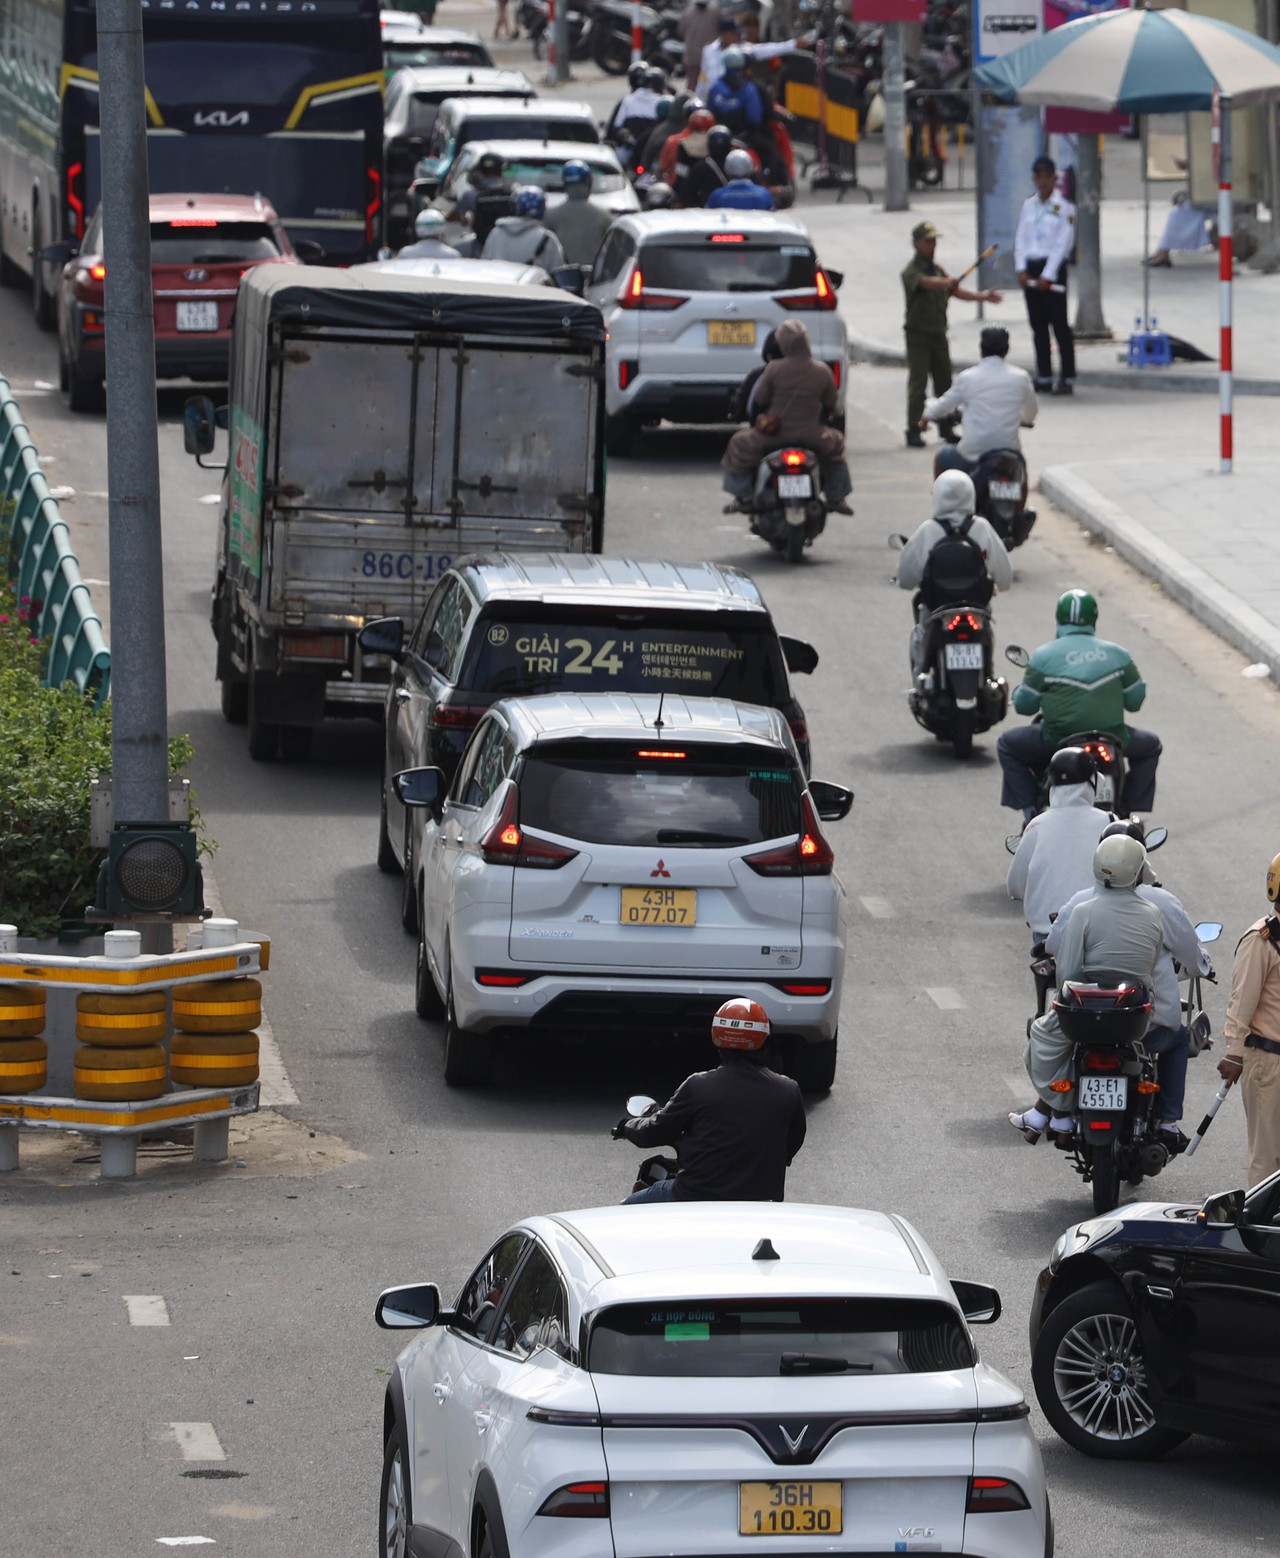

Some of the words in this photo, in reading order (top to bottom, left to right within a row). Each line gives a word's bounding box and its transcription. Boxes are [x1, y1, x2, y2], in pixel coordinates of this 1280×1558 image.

[194, 111, 249, 126] KIA
[491, 629, 505, 643] B2
[515, 632, 560, 655] GIẢI
[564, 638, 624, 675] 24
[622, 641, 634, 653] H
[641, 642, 745, 660] ENTERTAINMENT
[1065, 648, 1108, 666] Grab
[524, 657, 559, 673] TRI
[643, 890, 675, 906] 43H
[628, 907, 688, 923] 077.07
[1087, 1079, 1118, 1093] 43-E1
[1082, 1093, 1123, 1108] 455.16
[769, 1484, 813, 1506] 36H
[754, 1509, 831, 1531] 110.30
